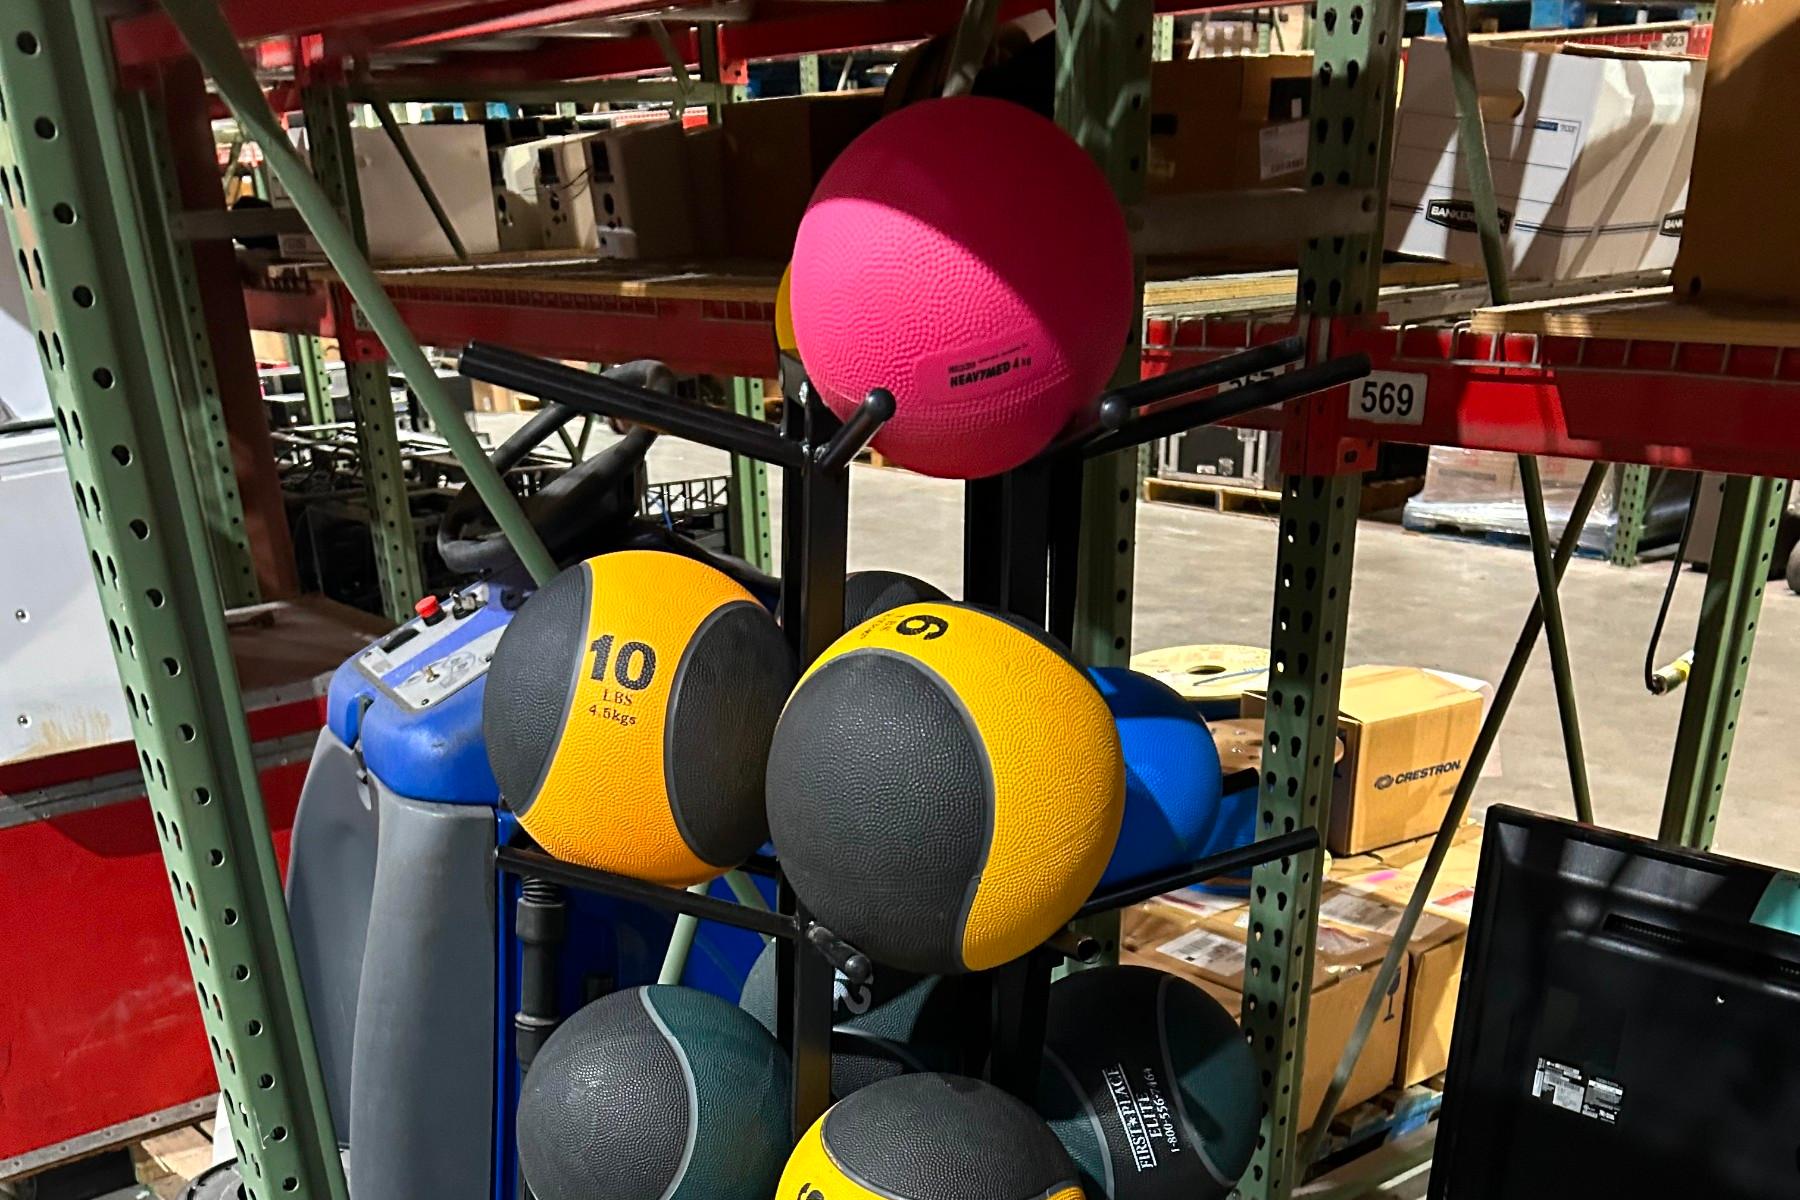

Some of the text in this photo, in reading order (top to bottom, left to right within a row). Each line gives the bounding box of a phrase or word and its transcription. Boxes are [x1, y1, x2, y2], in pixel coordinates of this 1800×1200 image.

[1360, 381, 1414, 416] 569
[590, 634, 657, 691] 10
[602, 688, 633, 706] LBS
[1136, 1092, 1162, 1138] ELITE
